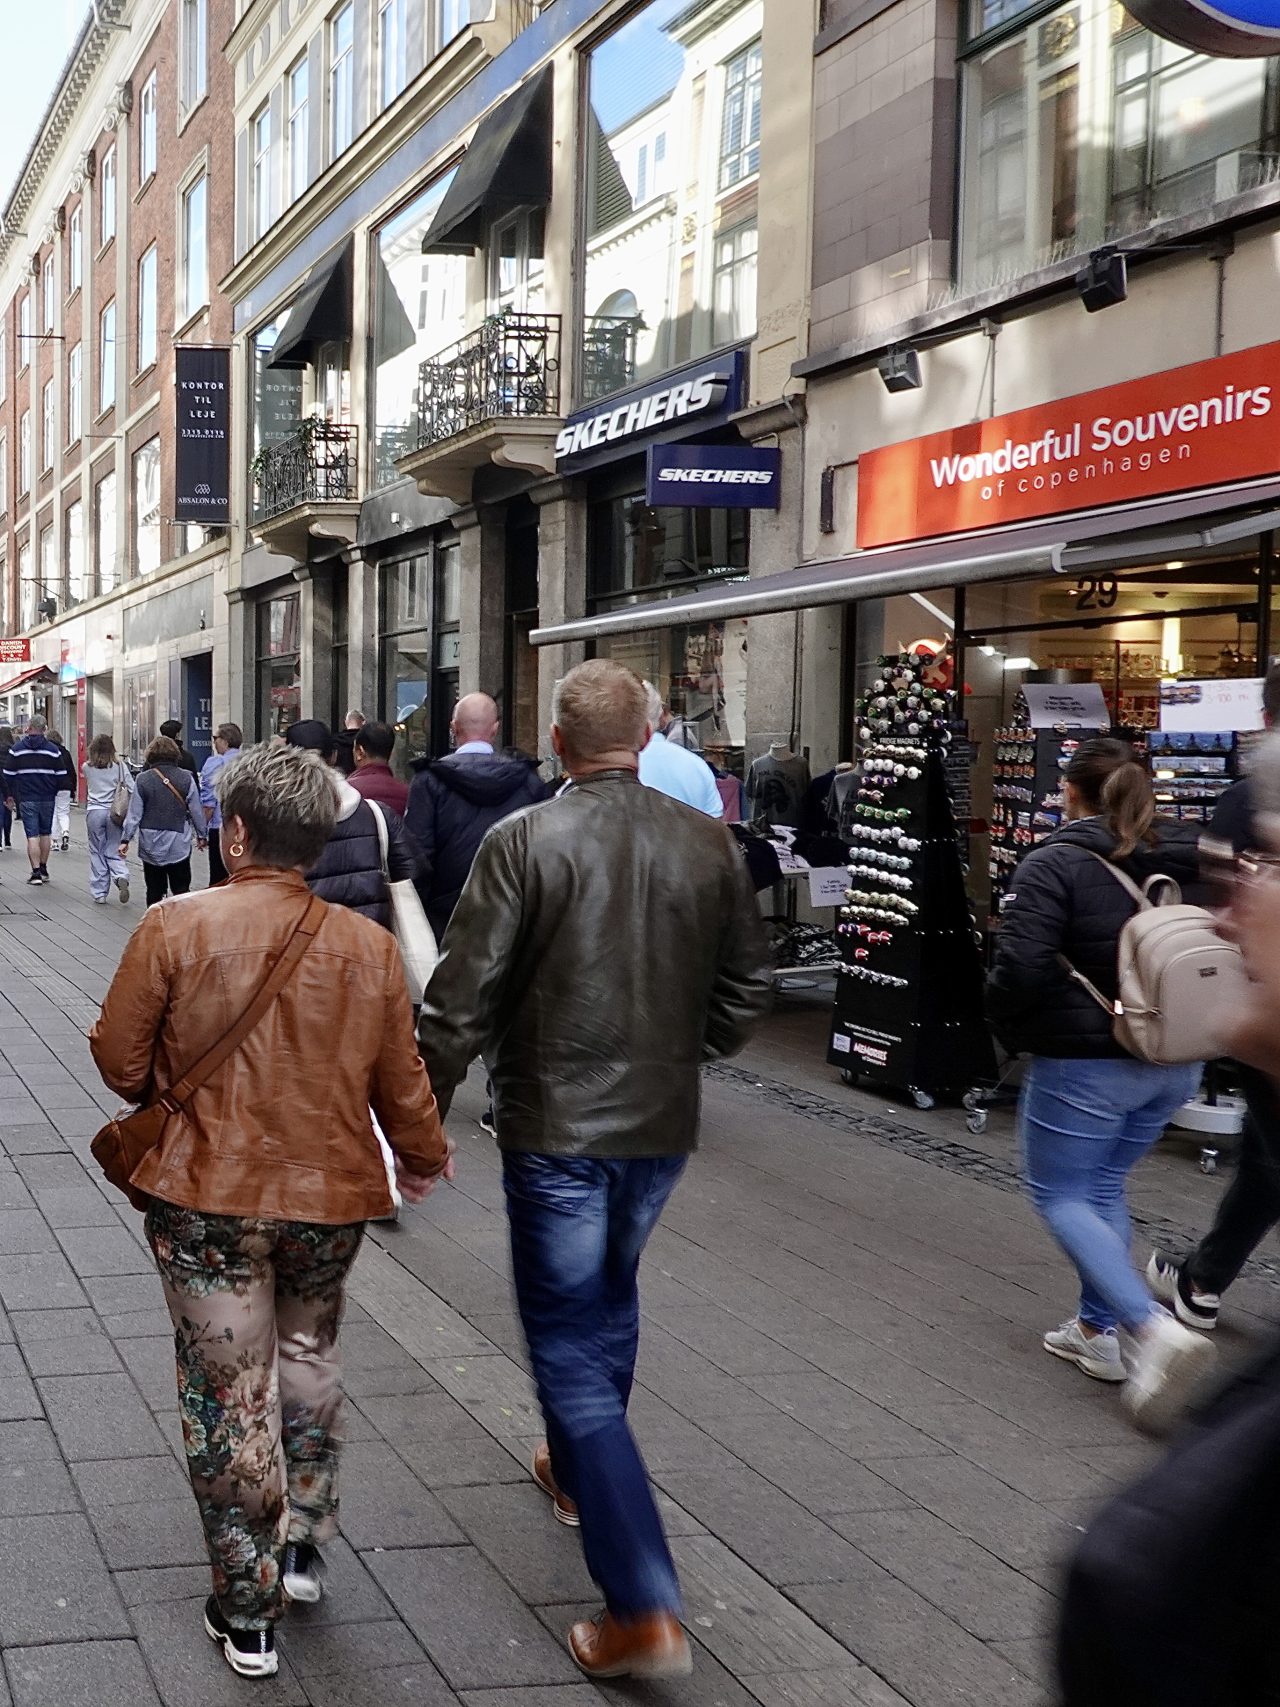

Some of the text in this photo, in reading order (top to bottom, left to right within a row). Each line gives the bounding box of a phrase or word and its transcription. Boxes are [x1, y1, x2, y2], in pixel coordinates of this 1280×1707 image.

[182, 381, 224, 390] KONTOR
[195, 396, 211, 404] TIL
[190, 410, 216, 418] LEJE
[555, 372, 722, 459] SKECHERS
[930, 385, 1272, 488] Wonderful Souvenirs
[658, 468, 774, 484] SKECHERS
[981, 442, 1191, 500] of copenhagen
[1076, 572, 1118, 611] 29
[453, 641, 460, 658] 2
[200, 698, 210, 712] TI
